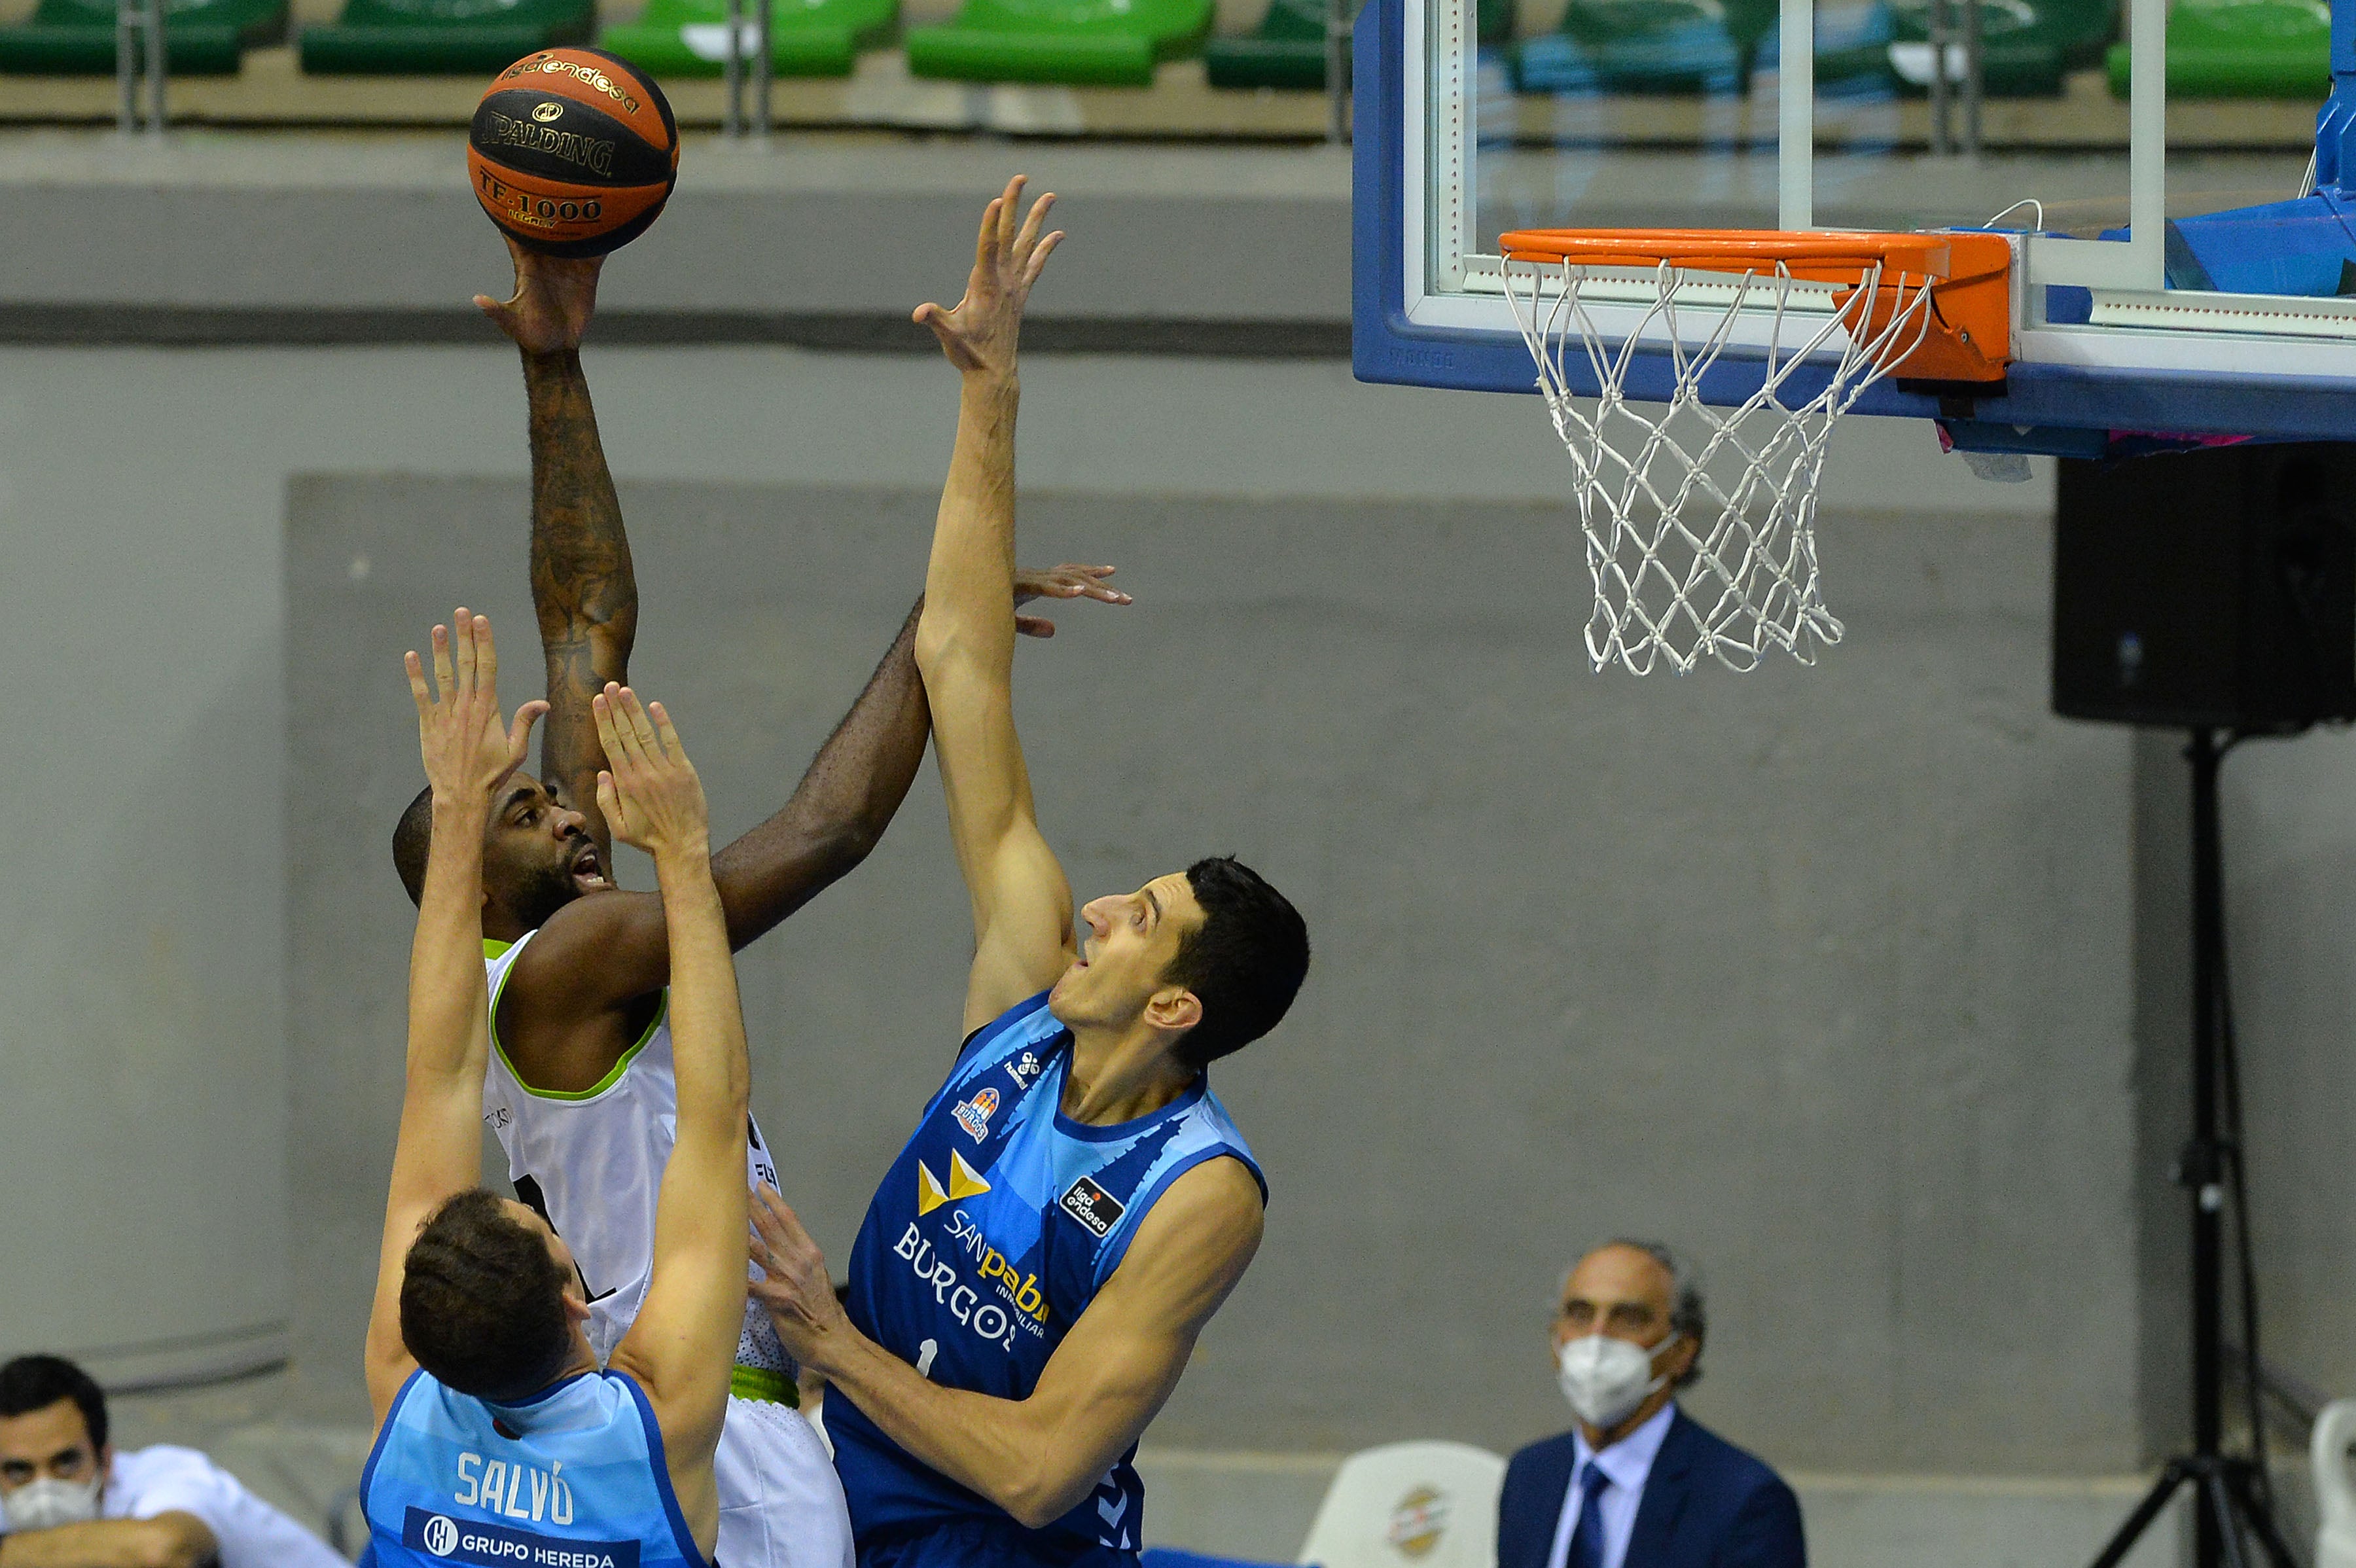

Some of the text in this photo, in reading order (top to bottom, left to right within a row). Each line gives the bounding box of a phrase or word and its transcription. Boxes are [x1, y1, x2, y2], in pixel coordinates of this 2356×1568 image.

[542, 60, 640, 114] endesa
[481, 111, 615, 175] SPALDING
[480, 168, 601, 221] TF-1000
[1004, 1061, 1028, 1090] hummel
[957, 1105, 986, 1137] BURGOS
[1067, 1196, 1107, 1232] endesa
[1073, 1186, 1094, 1207] liga
[454, 1452, 573, 1525] SALVÓ
[462, 1534, 529, 1560] GRUPO
[534, 1546, 615, 1568] HEREDA
